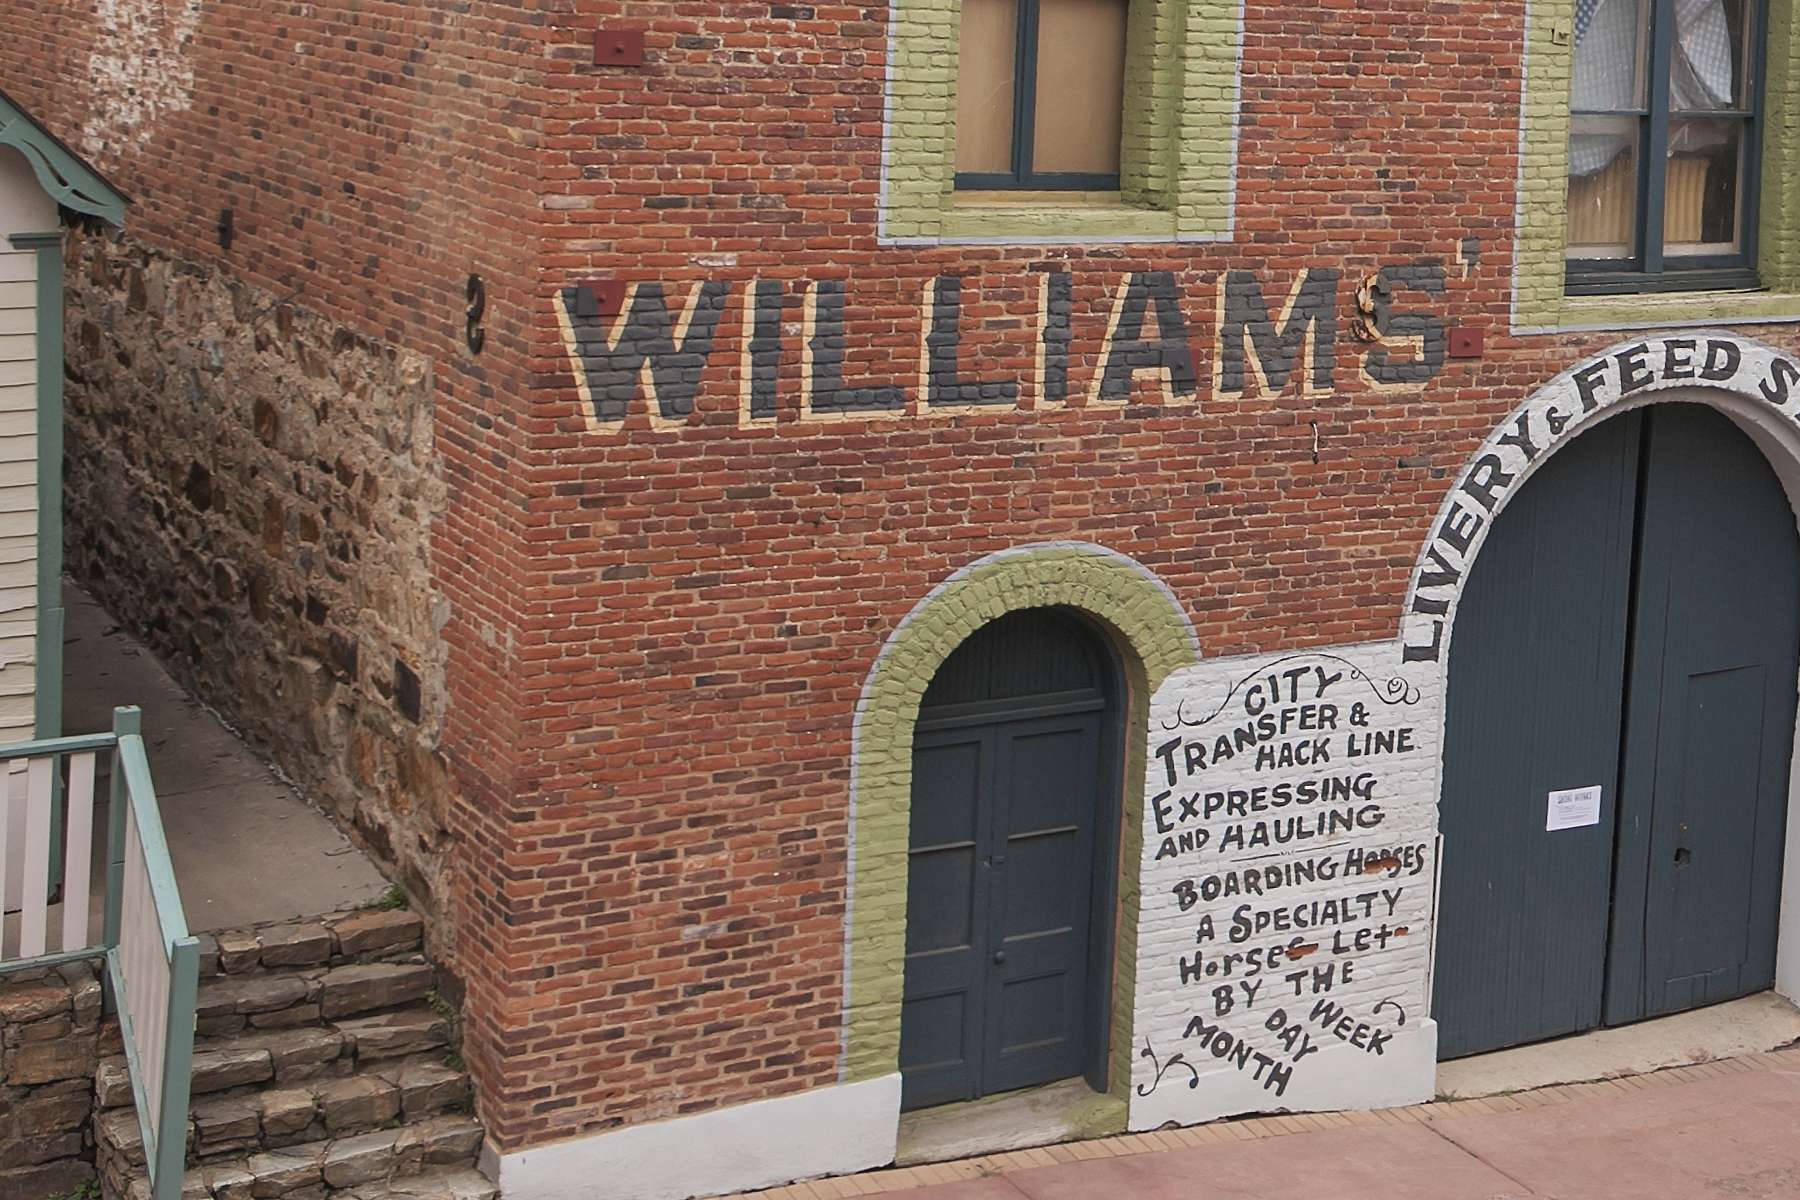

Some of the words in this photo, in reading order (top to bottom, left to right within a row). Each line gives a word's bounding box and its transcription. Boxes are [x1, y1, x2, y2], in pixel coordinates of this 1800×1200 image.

[1402, 408, 1542, 664] LIVERY
[1545, 405, 1573, 435] &
[1572, 338, 1742, 414] FEED
[1244, 665, 1343, 717] CITY
[1155, 703, 1339, 788] TRANSFER
[1349, 701, 1370, 728] &
[1255, 737, 1331, 773] HACK
[1347, 727, 1415, 758] LINE
[1151, 772, 1379, 834] EXPRESSING
[1154, 828, 1211, 861] AND
[1218, 804, 1386, 853] HAULING
[1172, 856, 1340, 912] BOARDING
[1195, 914, 1216, 945] A
[1228, 887, 1405, 944] SPECIALTY
[1212, 978, 1263, 1017] BY
[1285, 960, 1355, 997] THE
[1263, 1006, 1319, 1063] DAY
[1308, 998, 1394, 1056] WEEK
[1182, 1015, 1294, 1098] MONTH
